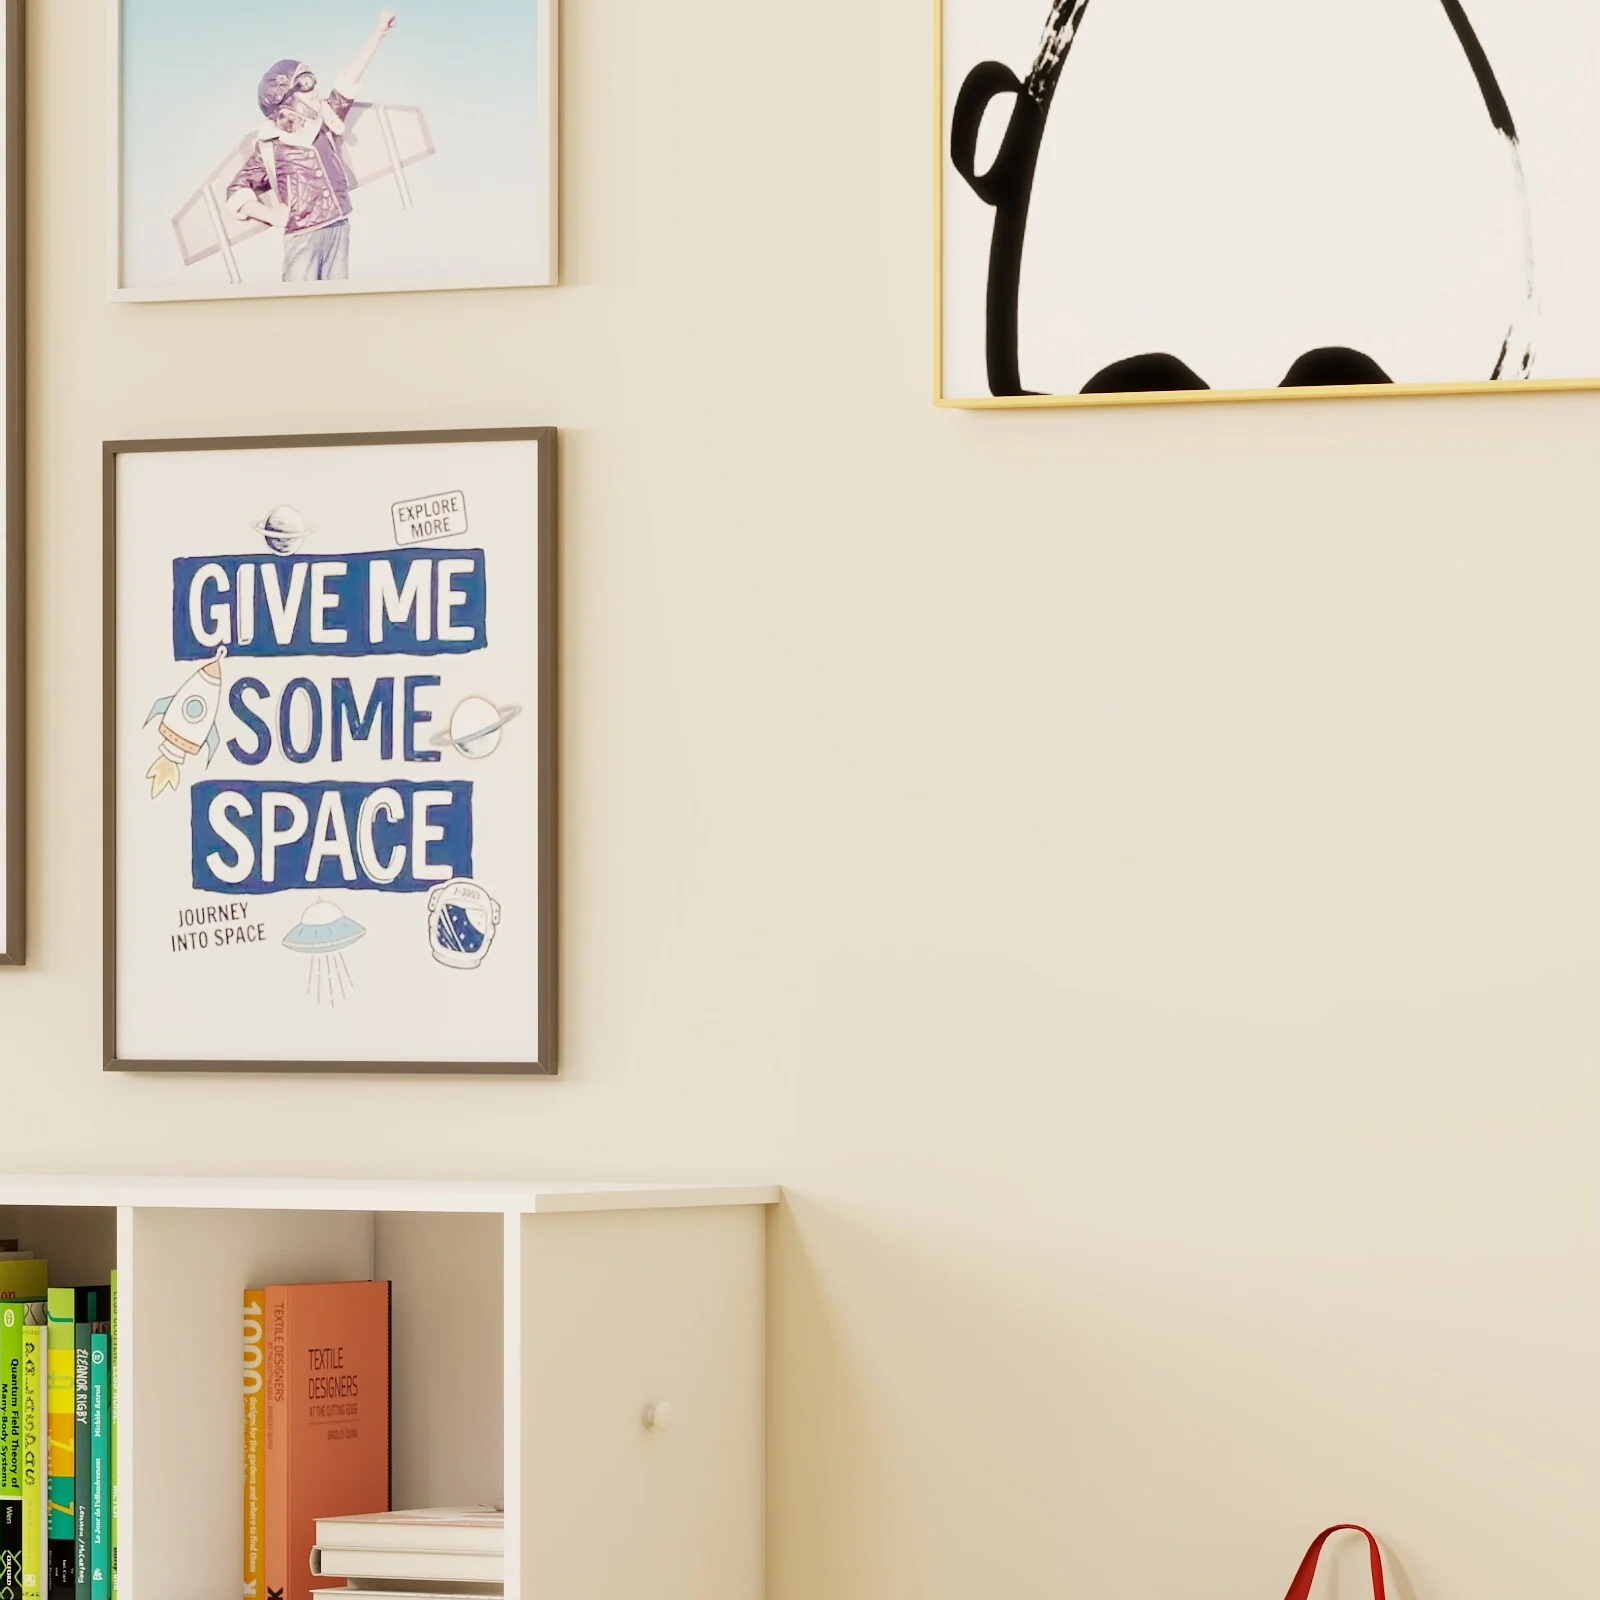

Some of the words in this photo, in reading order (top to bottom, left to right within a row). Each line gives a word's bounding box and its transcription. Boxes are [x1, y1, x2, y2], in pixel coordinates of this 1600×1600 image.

[398, 496, 460, 523] EXPLORE
[410, 516, 452, 538] MORE
[188, 561, 348, 648] GIVE
[368, 558, 476, 644] ME
[226, 675, 442, 766] SOME
[205, 787, 454, 884] SPACE
[177, 901, 249, 928] JOURNEY
[171, 931, 208, 952] INTO
[214, 923, 267, 948] SPACE
[274, 1303, 284, 1342] TEXTILE
[243, 1301, 263, 1394] 1000
[308, 1347, 343, 1370] TEXTILE
[10, 1358, 19, 1407] Quantum
[274, 1345, 284, 1402] DESIGNERS
[308, 1375, 358, 1399] DESIGNERS
[0, 1384, 8, 1442] Many-Body
[11, 1411, 19, 1435] Field
[76, 1394, 88, 1425] RIGBY
[0, 1444, 8, 1488] Systems
[9, 1439, 19, 1472] Theory
[11, 1474, 19, 1488] of
